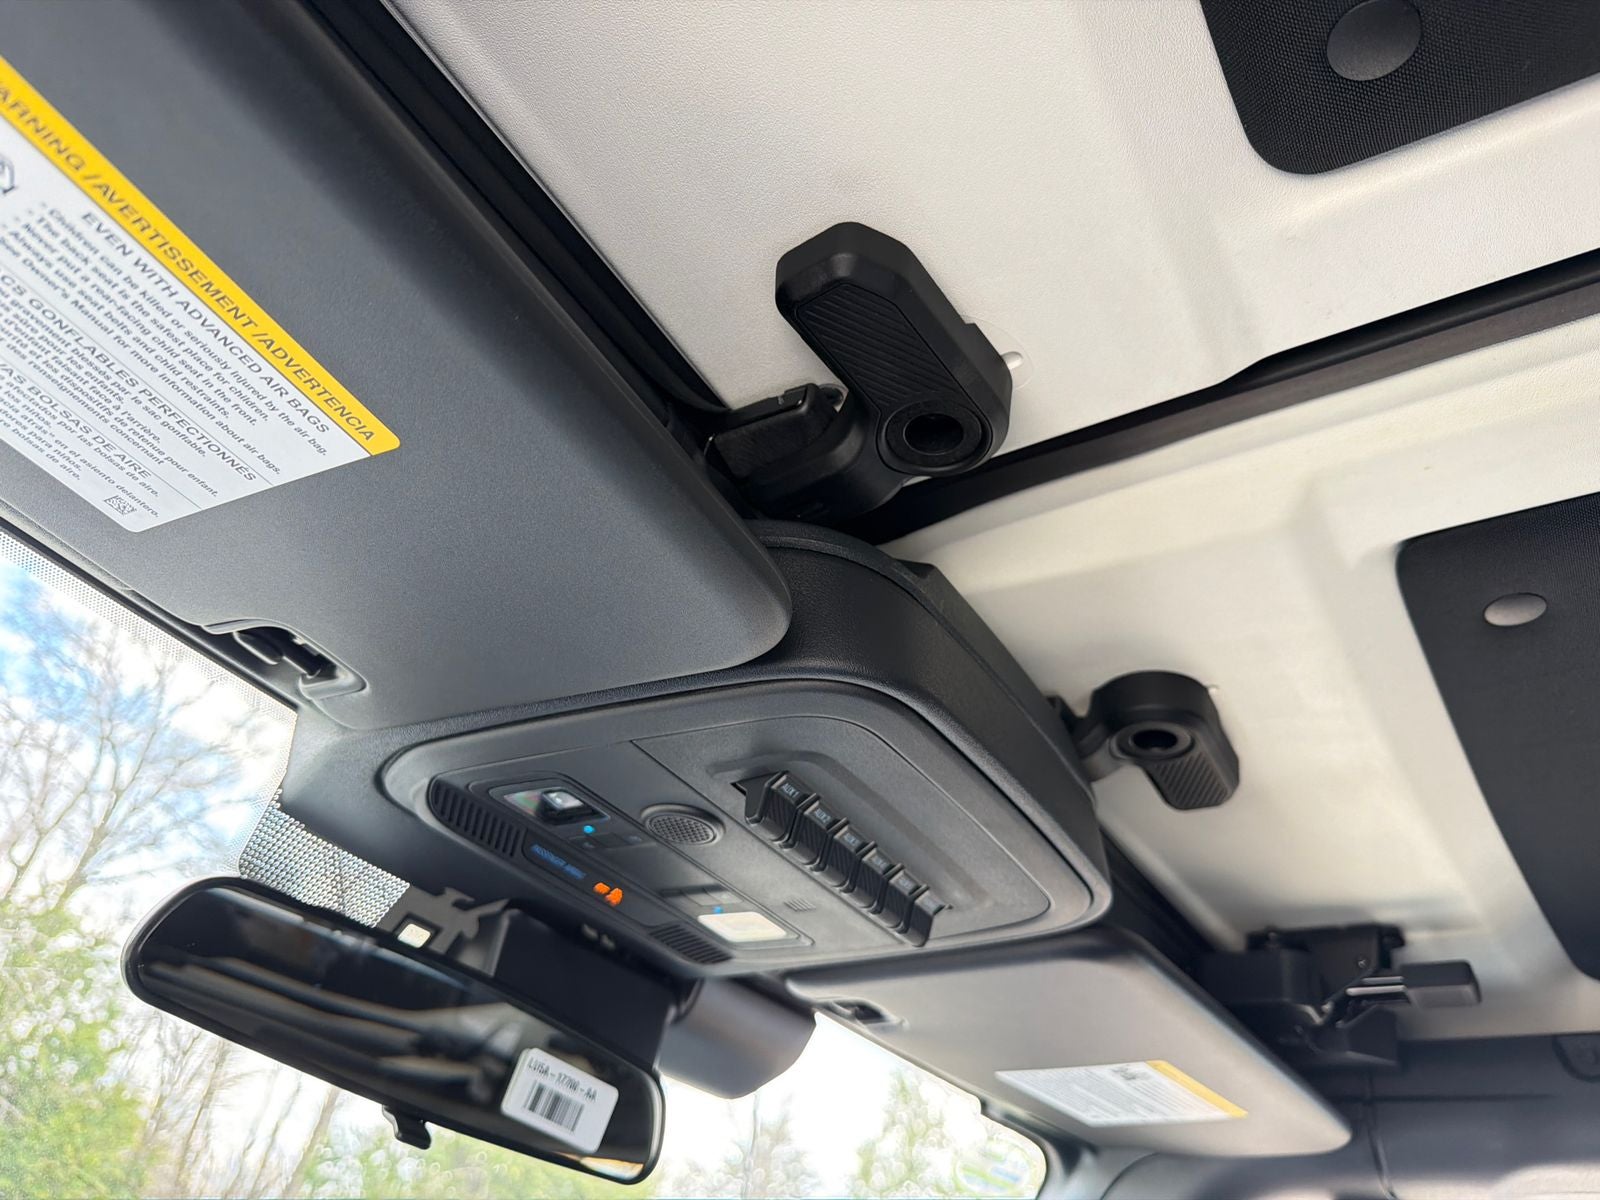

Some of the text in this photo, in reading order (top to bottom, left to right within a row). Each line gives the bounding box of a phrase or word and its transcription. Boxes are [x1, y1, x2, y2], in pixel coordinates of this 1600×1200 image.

[33, 216, 273, 421] The back seat is the safest place for children.
[53, 269, 78, 289] use
[76, 288, 106, 311] seat
[102, 310, 134, 334] belts
[130, 334, 156, 353] and
[153, 353, 184, 376] child
[179, 376, 234, 418] restraints.
[54, 254, 83, 275] put
[79, 274, 91, 283] a
[86, 282, 154, 336] rear-facing
[150, 334, 181, 358] child
[177, 358, 205, 378] seat
[200, 378, 216, 388] in
[212, 388, 234, 403] the
[229, 402, 260, 426] front.
[79, 211, 331, 433] EVEN WITH ADVANCED AIR BAGS
[82, 171, 258, 330] /AVERTISSEMENT
[252, 330, 377, 440] /ADVERTENCIA
[98, 255, 124, 275] can
[121, 274, 142, 289] be
[138, 289, 174, 318] killed
[169, 318, 186, 330] or
[180, 329, 234, 371] seriously
[226, 370, 268, 401] injured
[261, 400, 281, 413] by
[276, 412, 297, 426] the
[292, 426, 311, 438] air
[304, 438, 331, 456] bag.
[2, 390, 22, 404] los
[4, 343, 29, 360] des
[108, 423, 166, 464] concernant
[25, 297, 141, 387] GONFLABLES
[137, 387, 259, 481] PERFECTIONNÉS
[27, 349, 43, 359] et
[40, 359, 61, 374] les
[57, 374, 116, 417] dispositifs
[112, 415, 130, 427] de
[126, 427, 168, 456] retenue
[162, 456, 188, 473] pour
[185, 472, 221, 497] enfant.
[37, 334, 68, 357] pour
[65, 355, 86, 370] les
[83, 369, 129, 404] enfants.
[50, 355, 91, 385] faisant
[87, 385, 115, 404] face
[69, 299, 115, 335] Manual
[111, 335, 132, 349] for
[129, 349, 160, 373] more
[157, 372, 218, 420] information
[213, 419, 246, 442] about
[241, 442, 260, 454] air
[253, 454, 284, 475] bags.
[109, 381, 132, 396] par
[129, 395, 144, 405] le
[141, 405, 162, 420] sac
[158, 419, 210, 457] gonflable.
[10, 427, 48, 453] bolsas
[43, 452, 62, 463] de
[58, 463, 85, 480] aire.
[26, 385, 94, 434] BOLSAS
[91, 435, 118, 452] DE
[113, 451, 153, 478] AIRE
[26, 431, 54, 449] para
[52, 438, 69, 449] en
[67, 449, 81, 457] el
[78, 457, 118, 484] asiento
[114, 484, 163, 517] delantero.
[54, 420, 77, 435] por
[75, 434, 95, 447] las
[92, 446, 128, 471] bolsas
[124, 470, 141, 481] de
[137, 480, 163, 497] aire.
